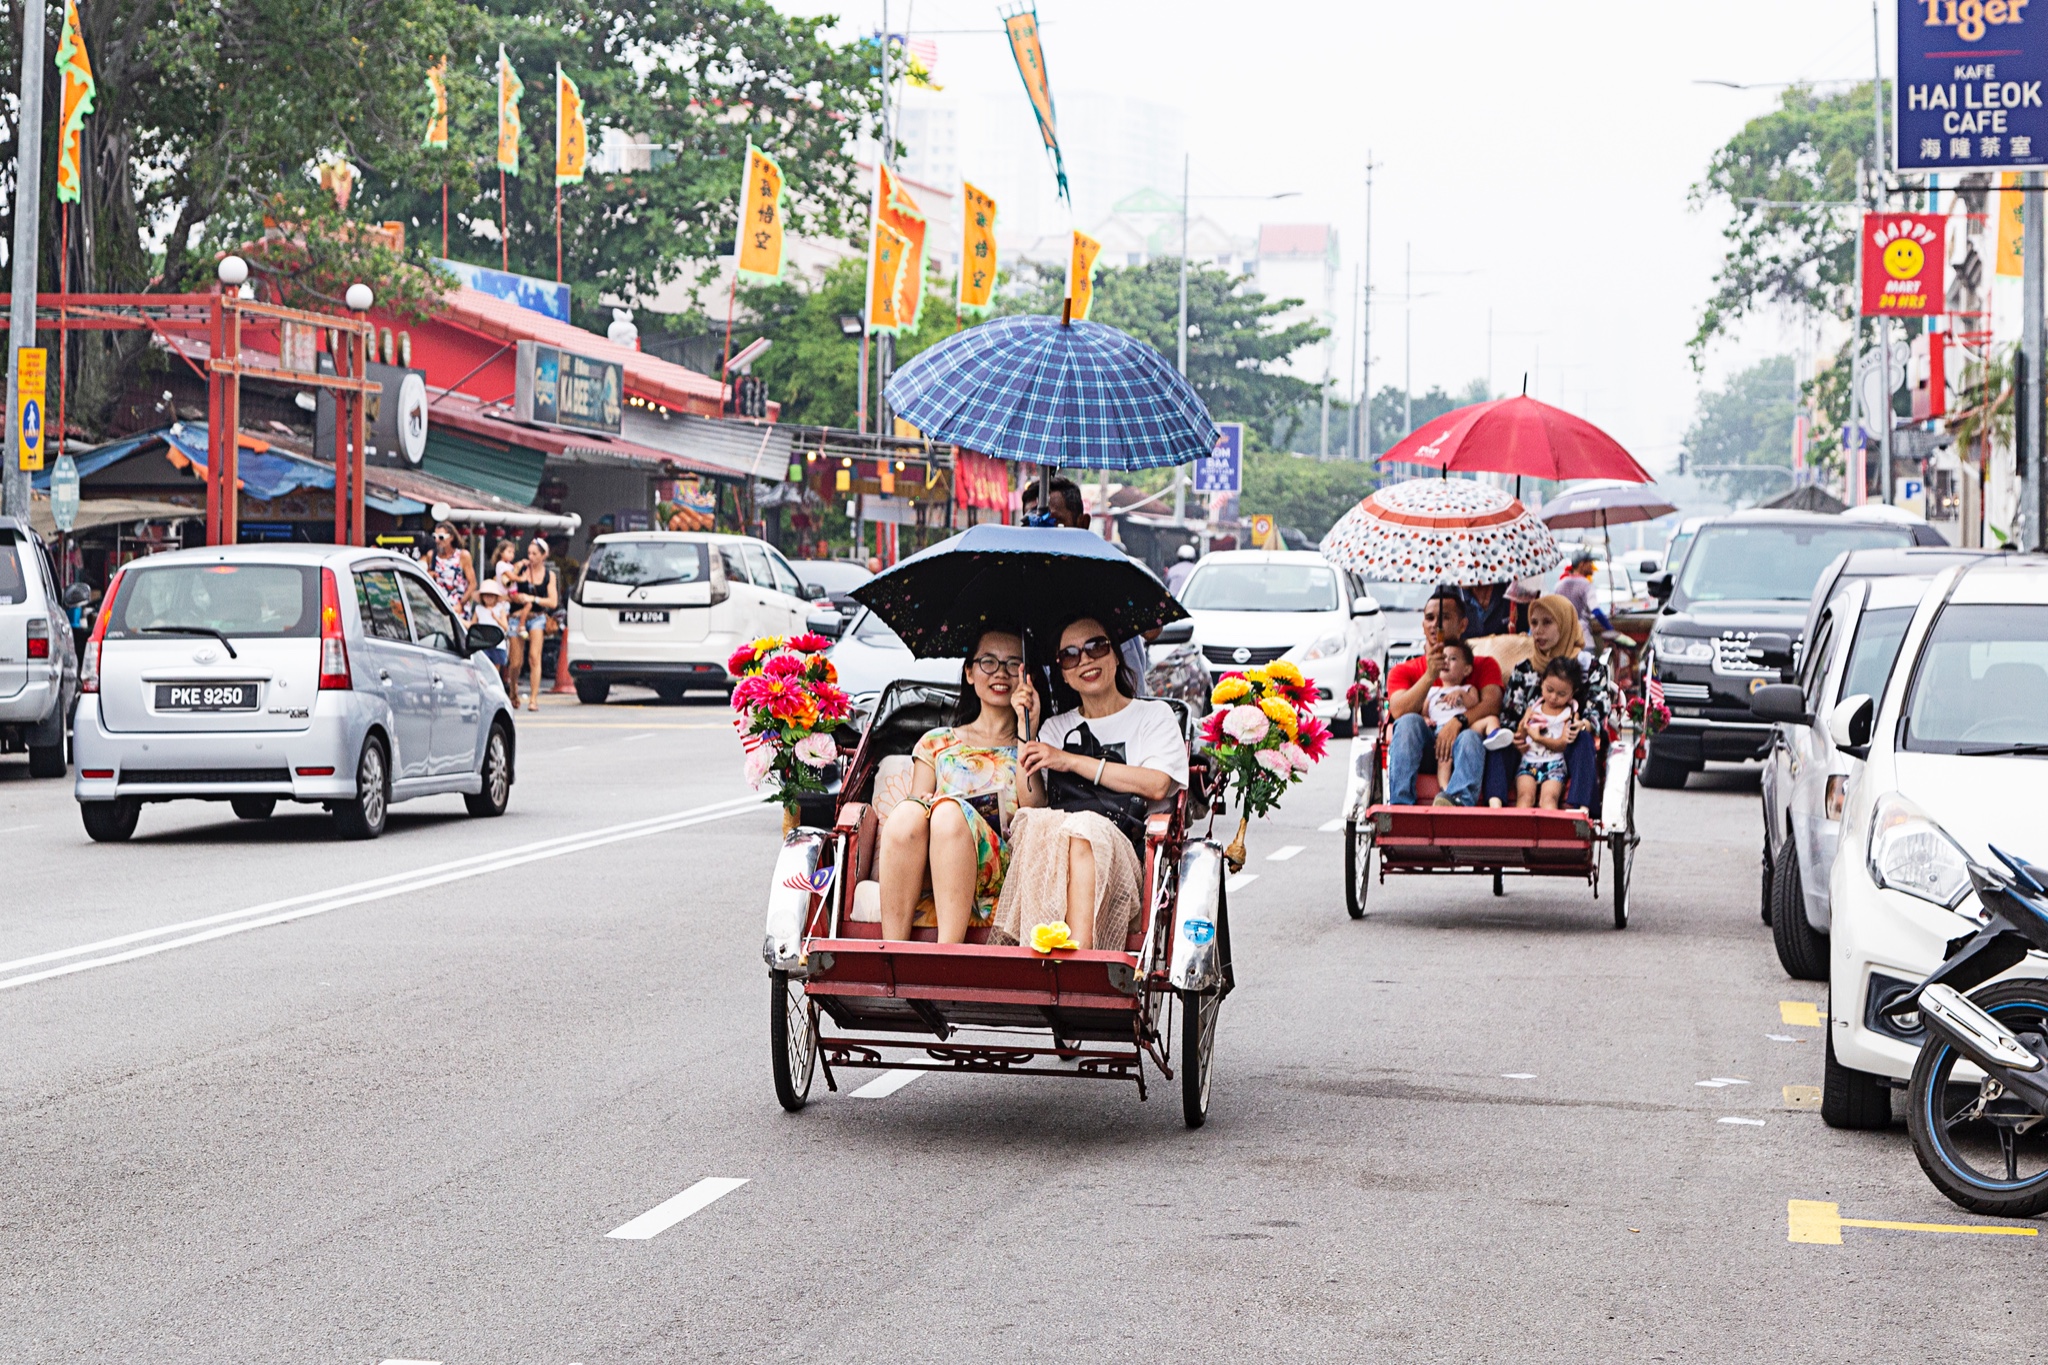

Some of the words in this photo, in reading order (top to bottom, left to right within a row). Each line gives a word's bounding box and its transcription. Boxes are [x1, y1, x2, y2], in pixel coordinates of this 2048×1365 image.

[1919, 0, 2029, 42] Tiger
[1954, 64, 1996, 80] KAFE
[1908, 83, 1957, 111] HAI
[1964, 81, 2043, 109] LEOK
[1943, 110, 2008, 134] CAFE
[1920, 136, 2031, 160] 海隆茶室
[1873, 219, 1937, 249] HAPPY
[1884, 280, 1922, 294] MART
[1906, 482, 1921, 499] P
[625, 611, 641, 622] PLP
[171, 687, 201, 705] PKE
[204, 687, 242, 704] 9250
